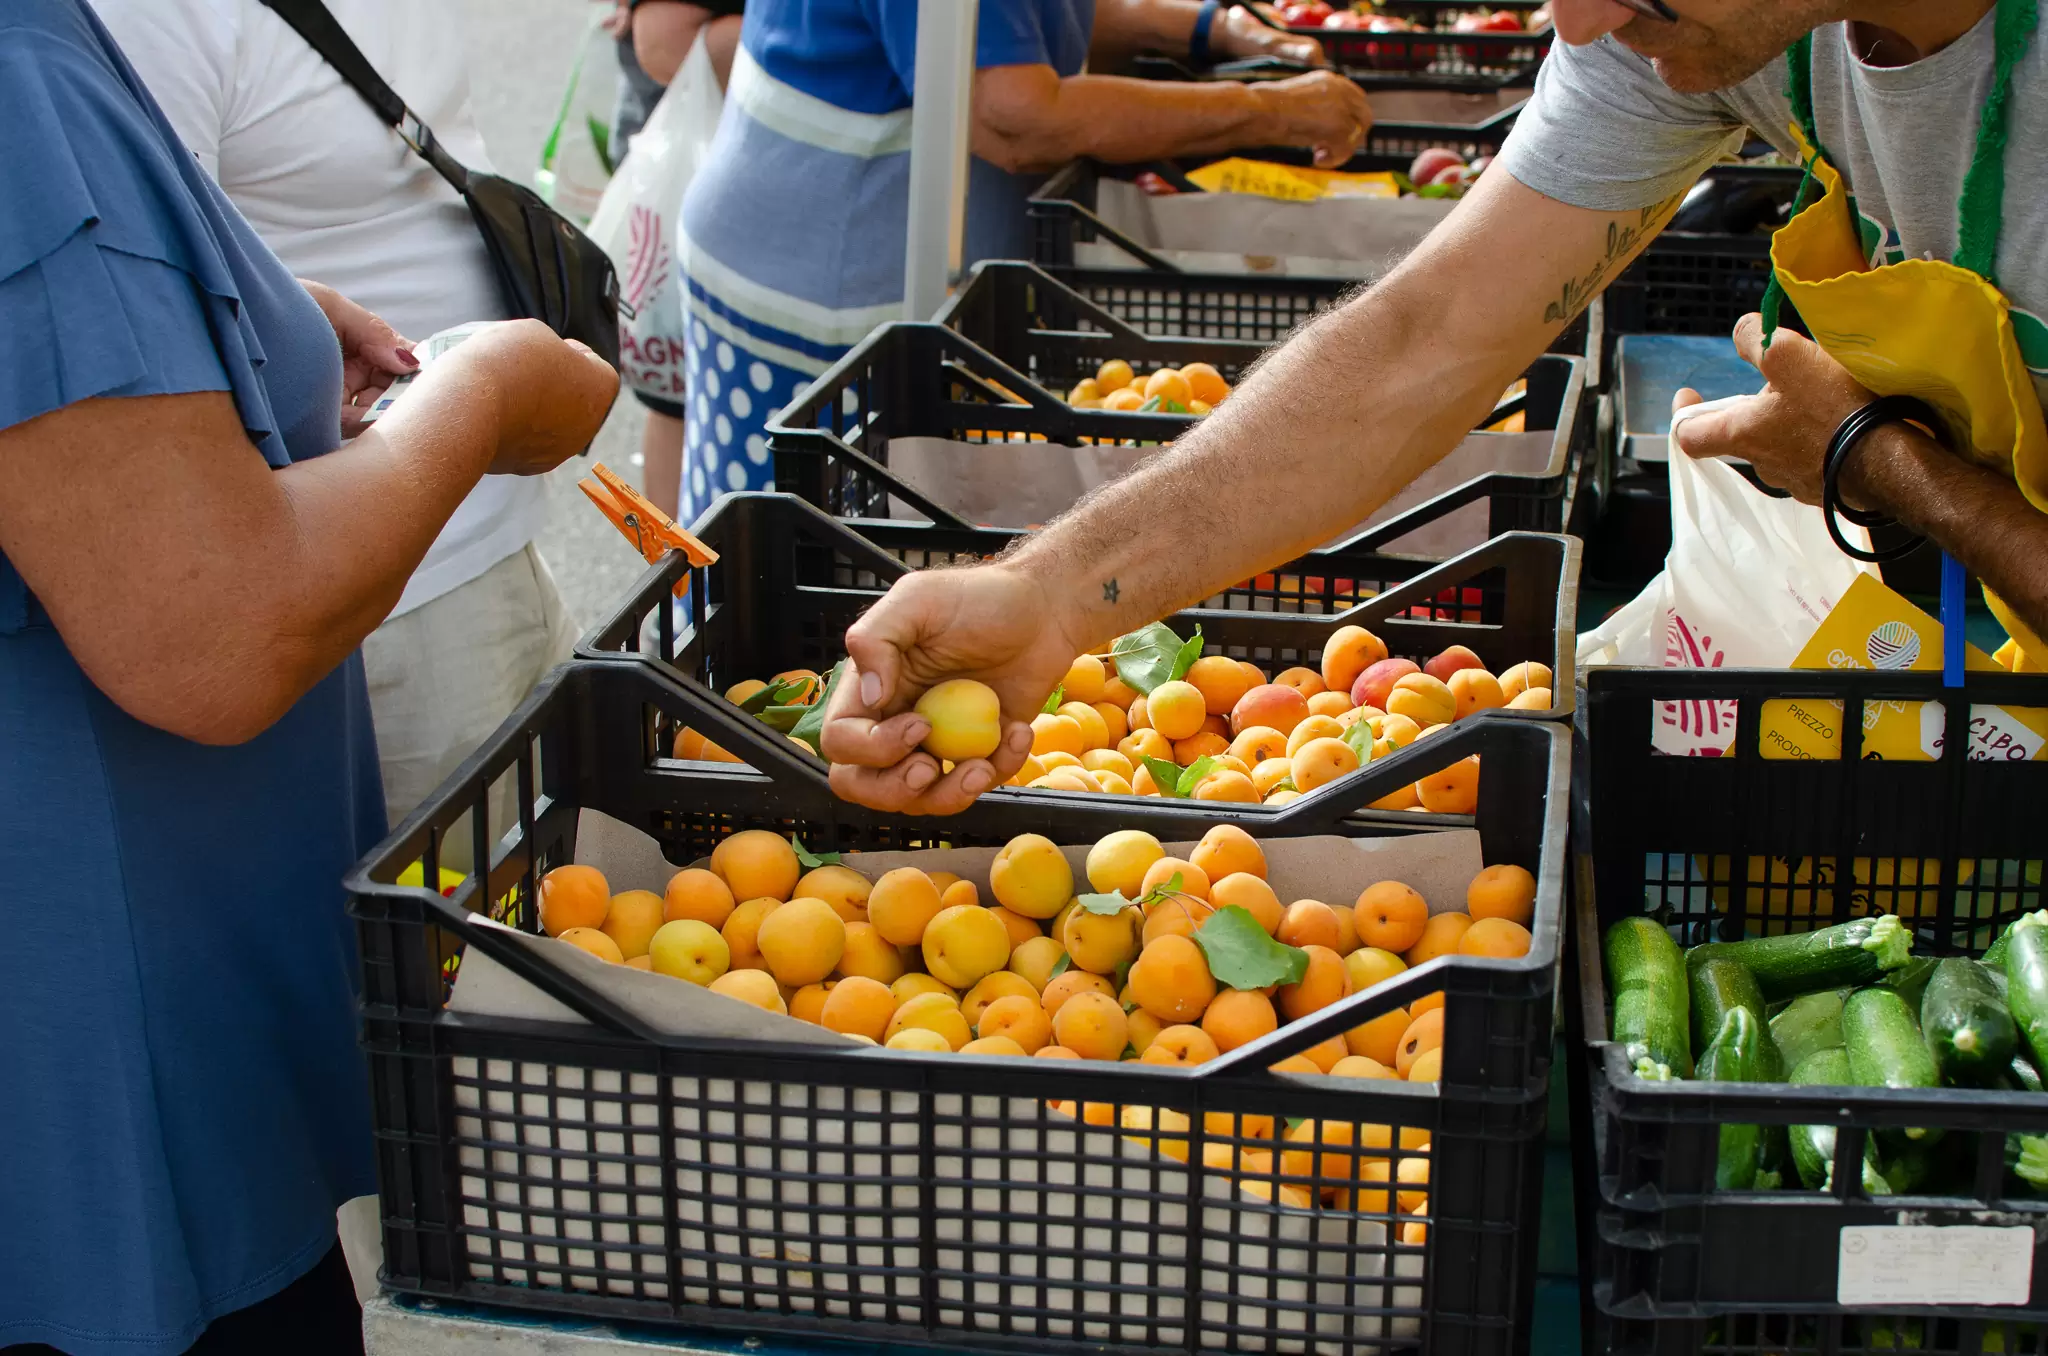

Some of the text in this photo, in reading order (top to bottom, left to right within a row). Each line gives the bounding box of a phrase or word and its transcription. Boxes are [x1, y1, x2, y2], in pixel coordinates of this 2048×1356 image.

[1786, 703, 1834, 739] PREZZO
[1968, 717, 2026, 761] CIBO
[1766, 730, 1817, 761] PRODO
